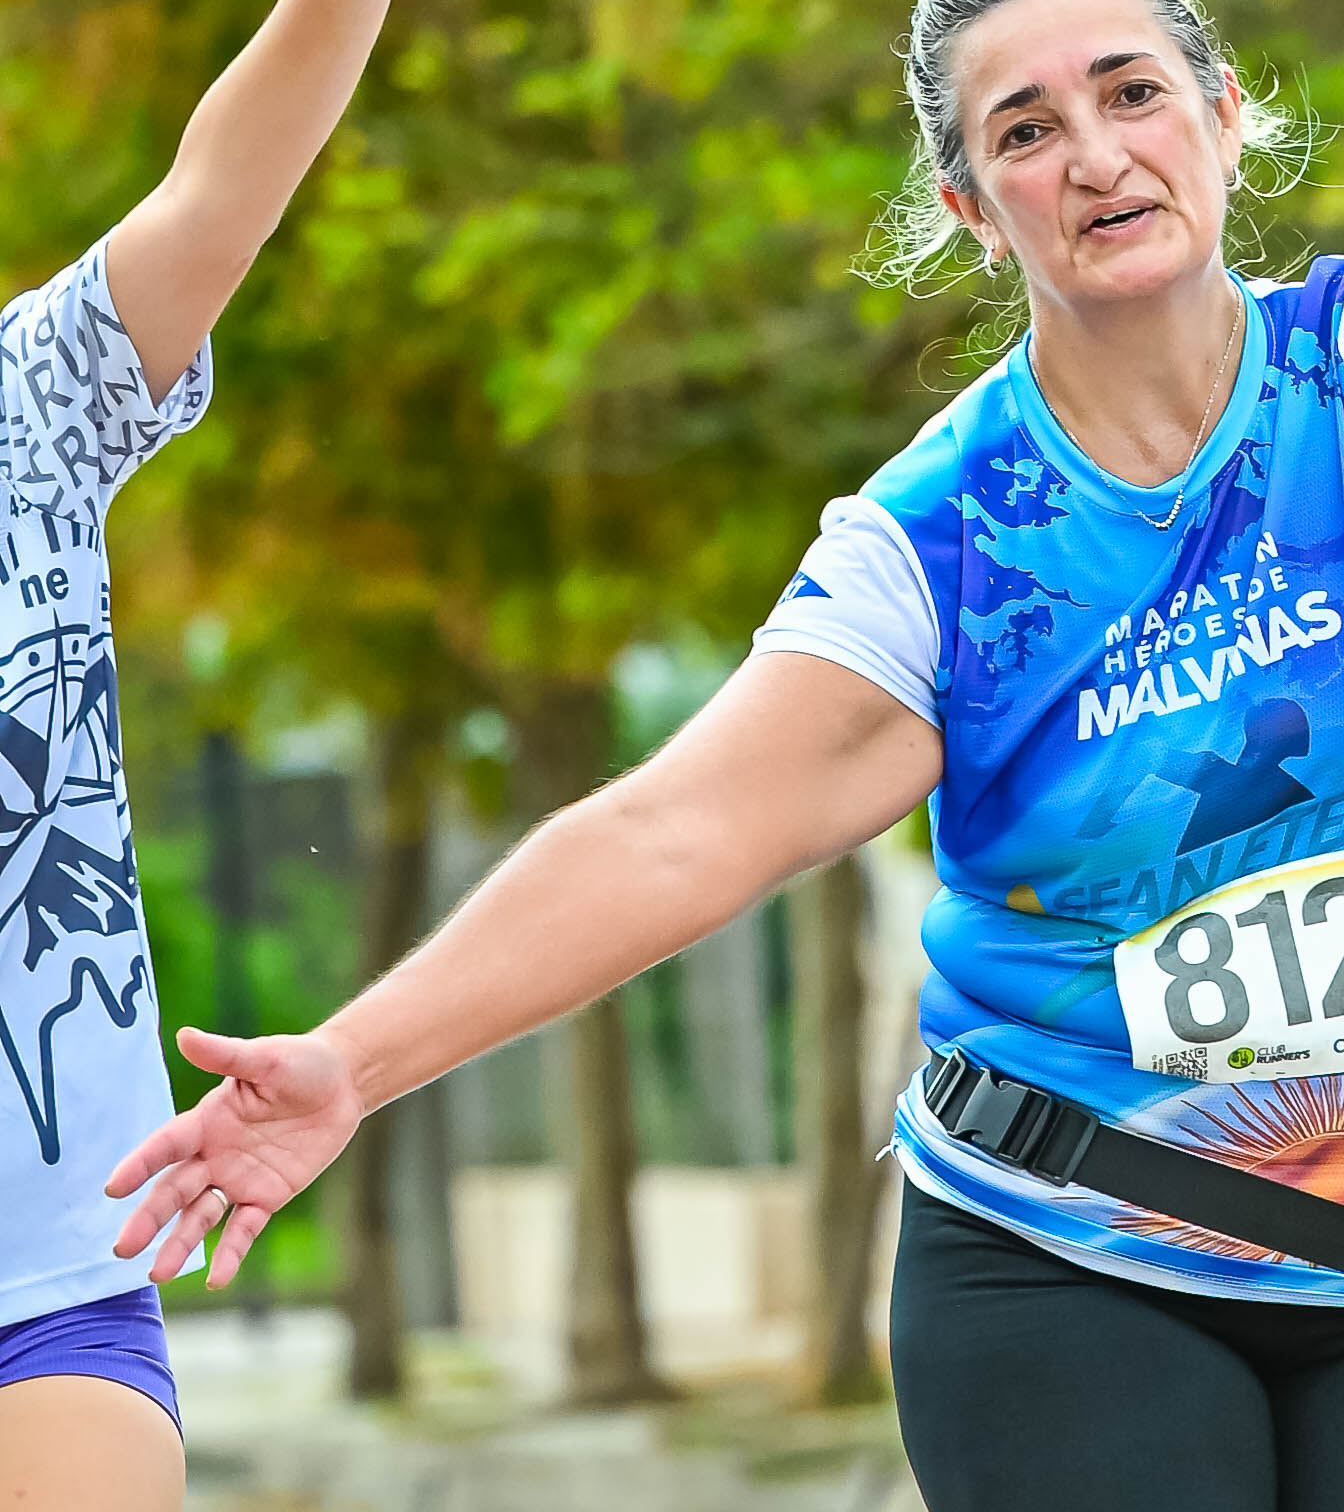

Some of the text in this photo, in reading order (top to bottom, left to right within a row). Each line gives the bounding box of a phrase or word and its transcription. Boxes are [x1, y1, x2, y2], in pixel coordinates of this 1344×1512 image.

[1105, 531, 1279, 647] MARATN
[1077, 590, 1342, 741] MALVNAS
[1256, 1044, 1287, 1056] CLUB
